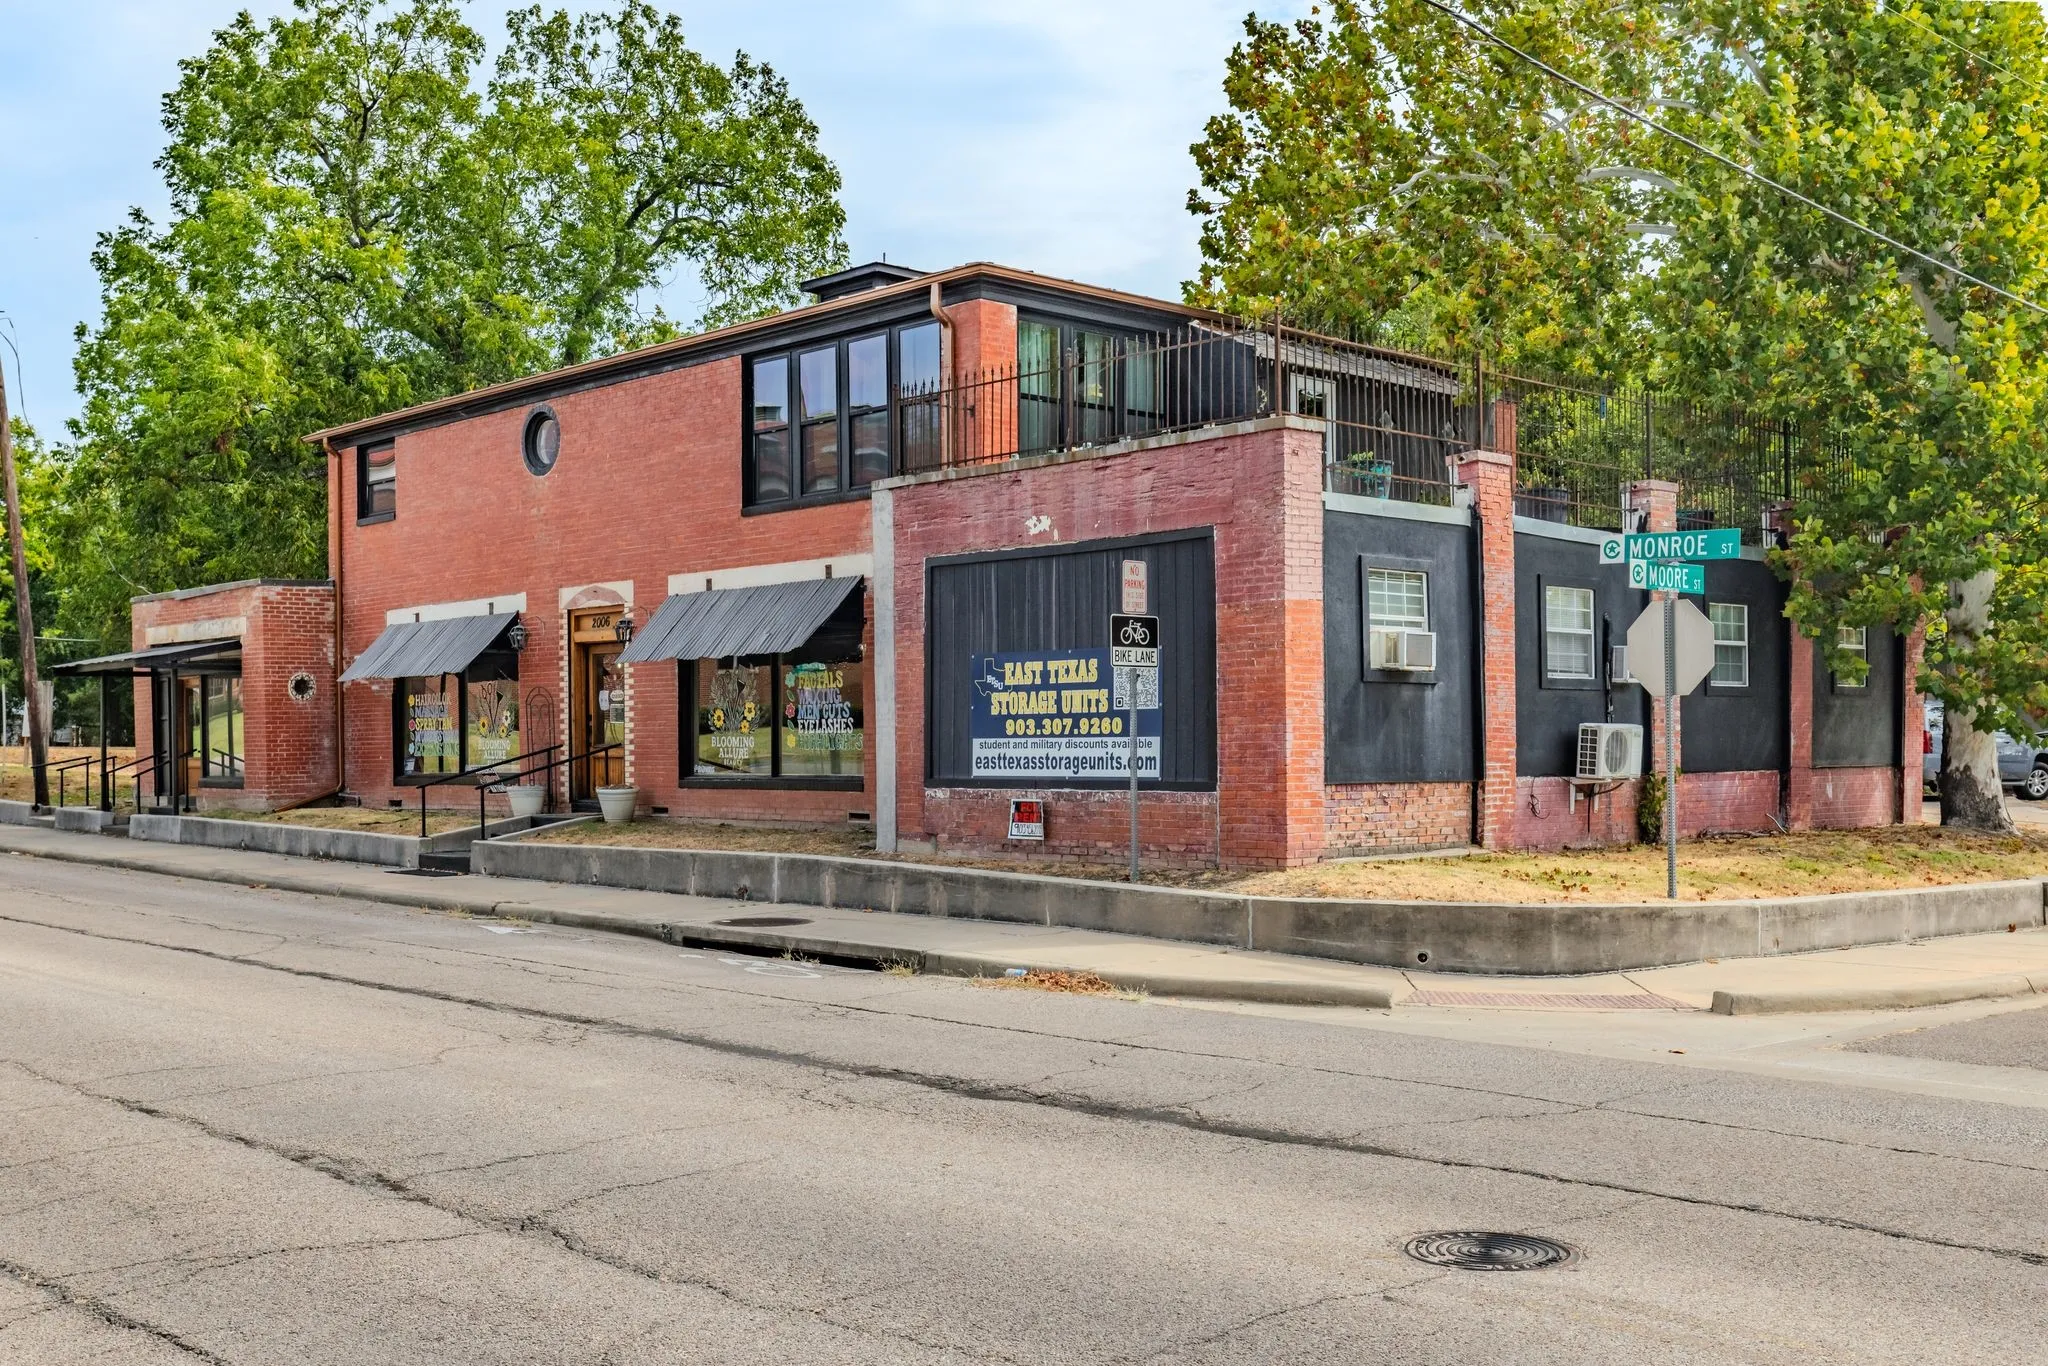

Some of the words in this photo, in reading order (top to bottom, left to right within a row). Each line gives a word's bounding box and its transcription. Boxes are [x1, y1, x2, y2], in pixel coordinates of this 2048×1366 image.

[1629, 535, 1708, 558] MONROE
[1721, 543, 1734, 555] ST
[1129, 565, 1139, 577] NO
[1649, 565, 1689, 589] MOORE
[1693, 579, 1701, 590] ST
[1124, 579, 1145, 590] PARKING
[592, 616, 610, 629] 2006
[1114, 649, 1132, 662] BIKE
[1135, 650, 1155, 663] LANE
[798, 671, 844, 689] FACIALS
[1004, 661, 1044, 686] EAST
[1047, 658, 1098, 684] TEXAS
[797, 688, 842, 704] WAXING
[990, 690, 1057, 715] STORAGE
[1061, 688, 1109, 713] UNITS
[823, 701, 851, 719] CUTS
[415, 718, 437, 731] SPRAY
[797, 717, 854, 734] EYELASHES
[1005, 717, 1123, 736] 903.307.9260
[711, 736, 755, 748] BLOOMING
[979, 739, 1011, 749] student
[1012, 739, 1028, 749] and
[1030, 738, 1063, 752] military
[1064, 738, 1109, 749] discounts
[1111, 738, 1153, 749] avaible
[718, 748, 749, 759] ALLURE
